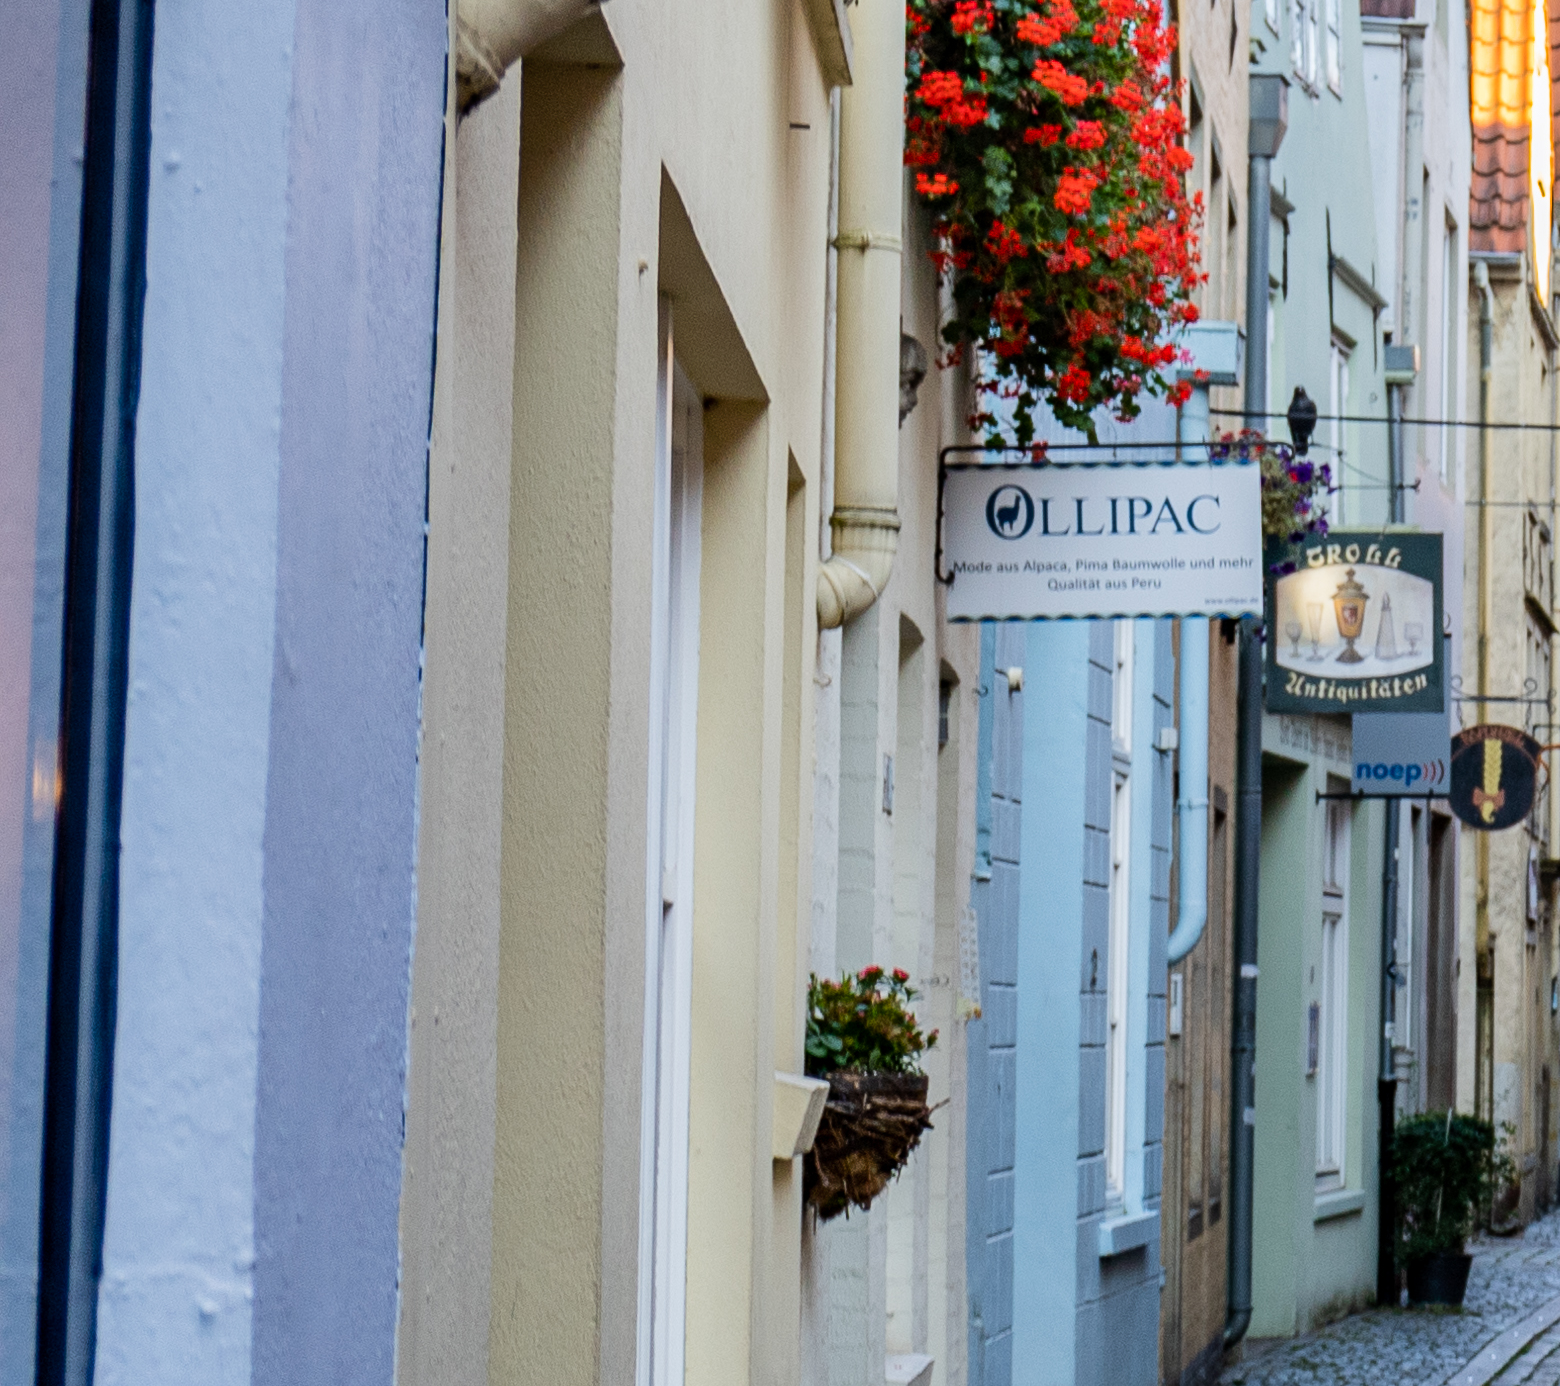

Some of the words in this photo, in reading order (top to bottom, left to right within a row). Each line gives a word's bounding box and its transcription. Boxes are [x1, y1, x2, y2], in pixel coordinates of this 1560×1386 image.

[985, 484, 1222, 541] OLLIPAC
[953, 562, 993, 574] Mode
[996, 562, 1019, 573] aus
[1022, 560, 1071, 575] Alpaca,
[1075, 559, 1109, 572] Pima
[1112, 558, 1186, 572] Baumwolle
[1190, 557, 1215, 570] und
[1219, 557, 1254, 569] mehr
[1306, 543, 1401, 568] TROLL
[1047, 577, 1101, 592] Qualität
[1105, 579, 1128, 590] aus
[1131, 577, 1162, 590] Peru
[1285, 671, 1428, 704] Antiquitäten
[1356, 761, 1422, 786] noep
